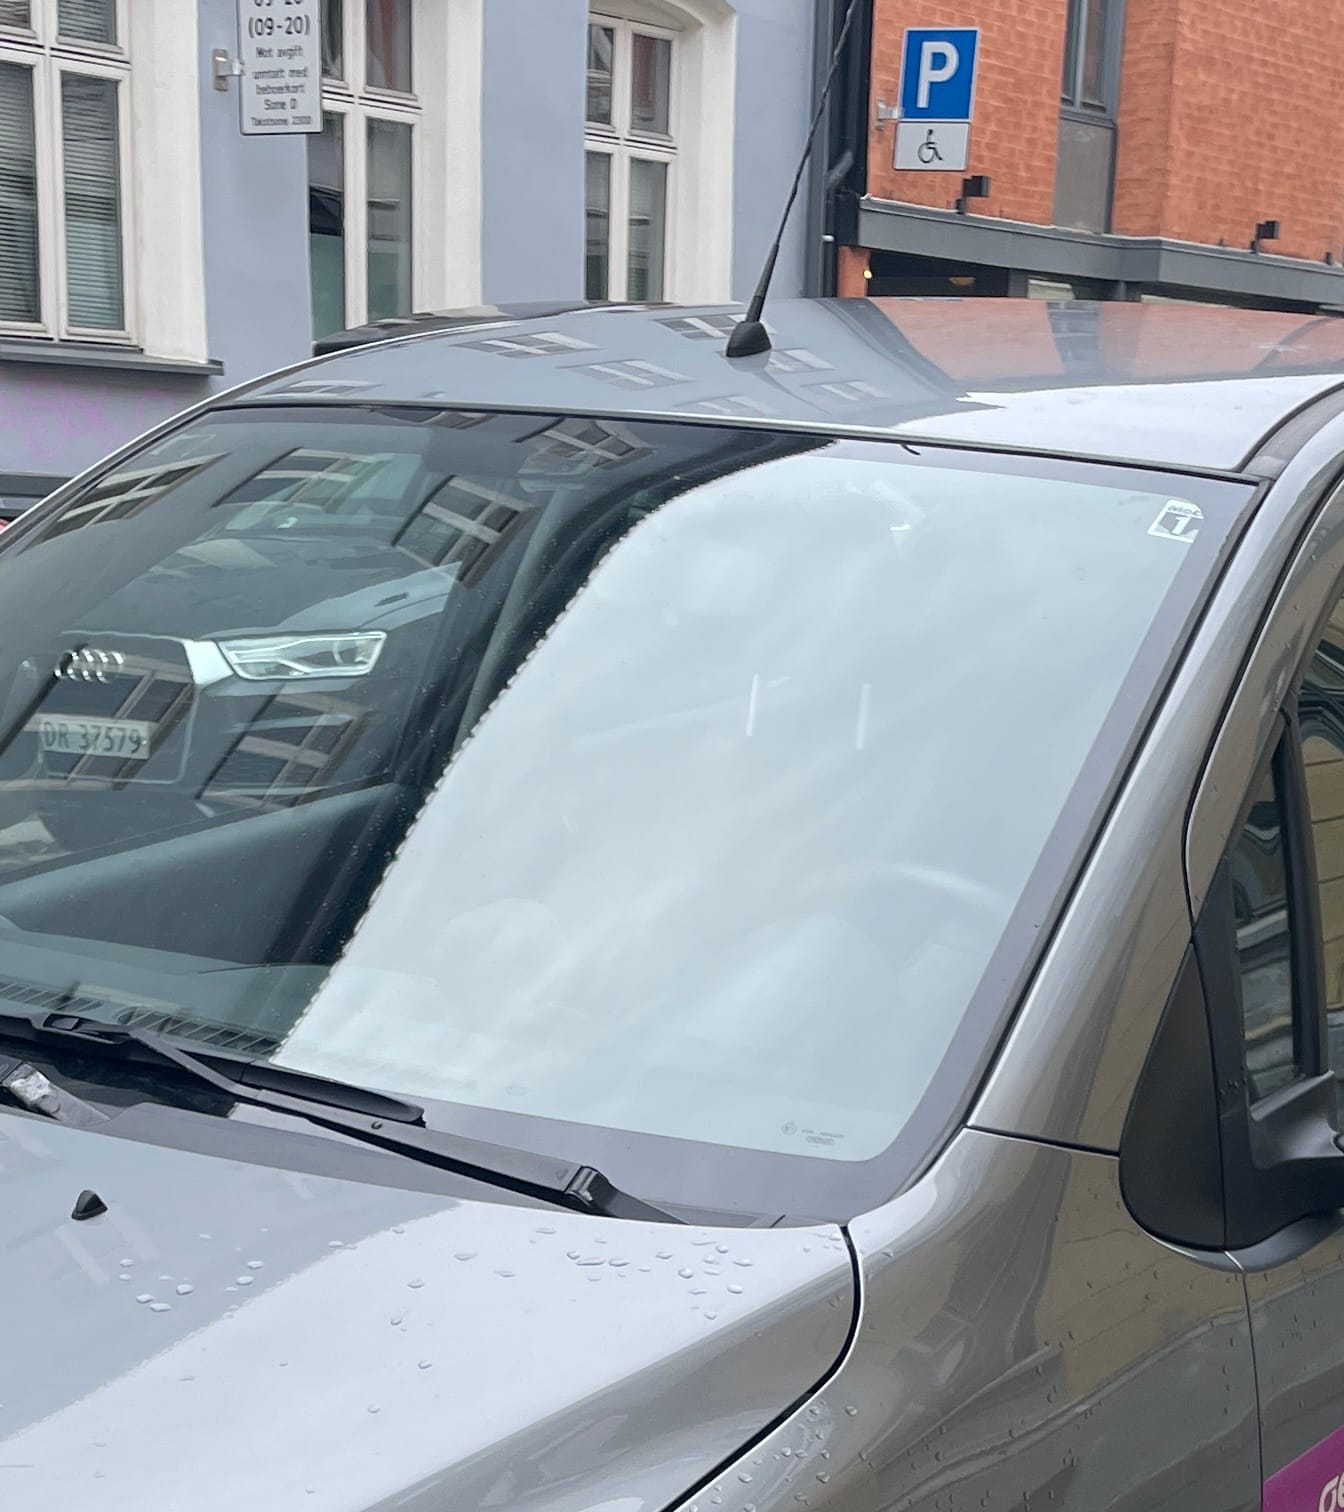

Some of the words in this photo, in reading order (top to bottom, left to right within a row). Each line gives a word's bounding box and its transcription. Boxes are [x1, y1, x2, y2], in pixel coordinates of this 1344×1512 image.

[248, 14, 311, 38] (09-20)
[916, 41, 960, 109] P
[43, 721, 70, 749] DR
[78, 723, 141, 755] 37579
